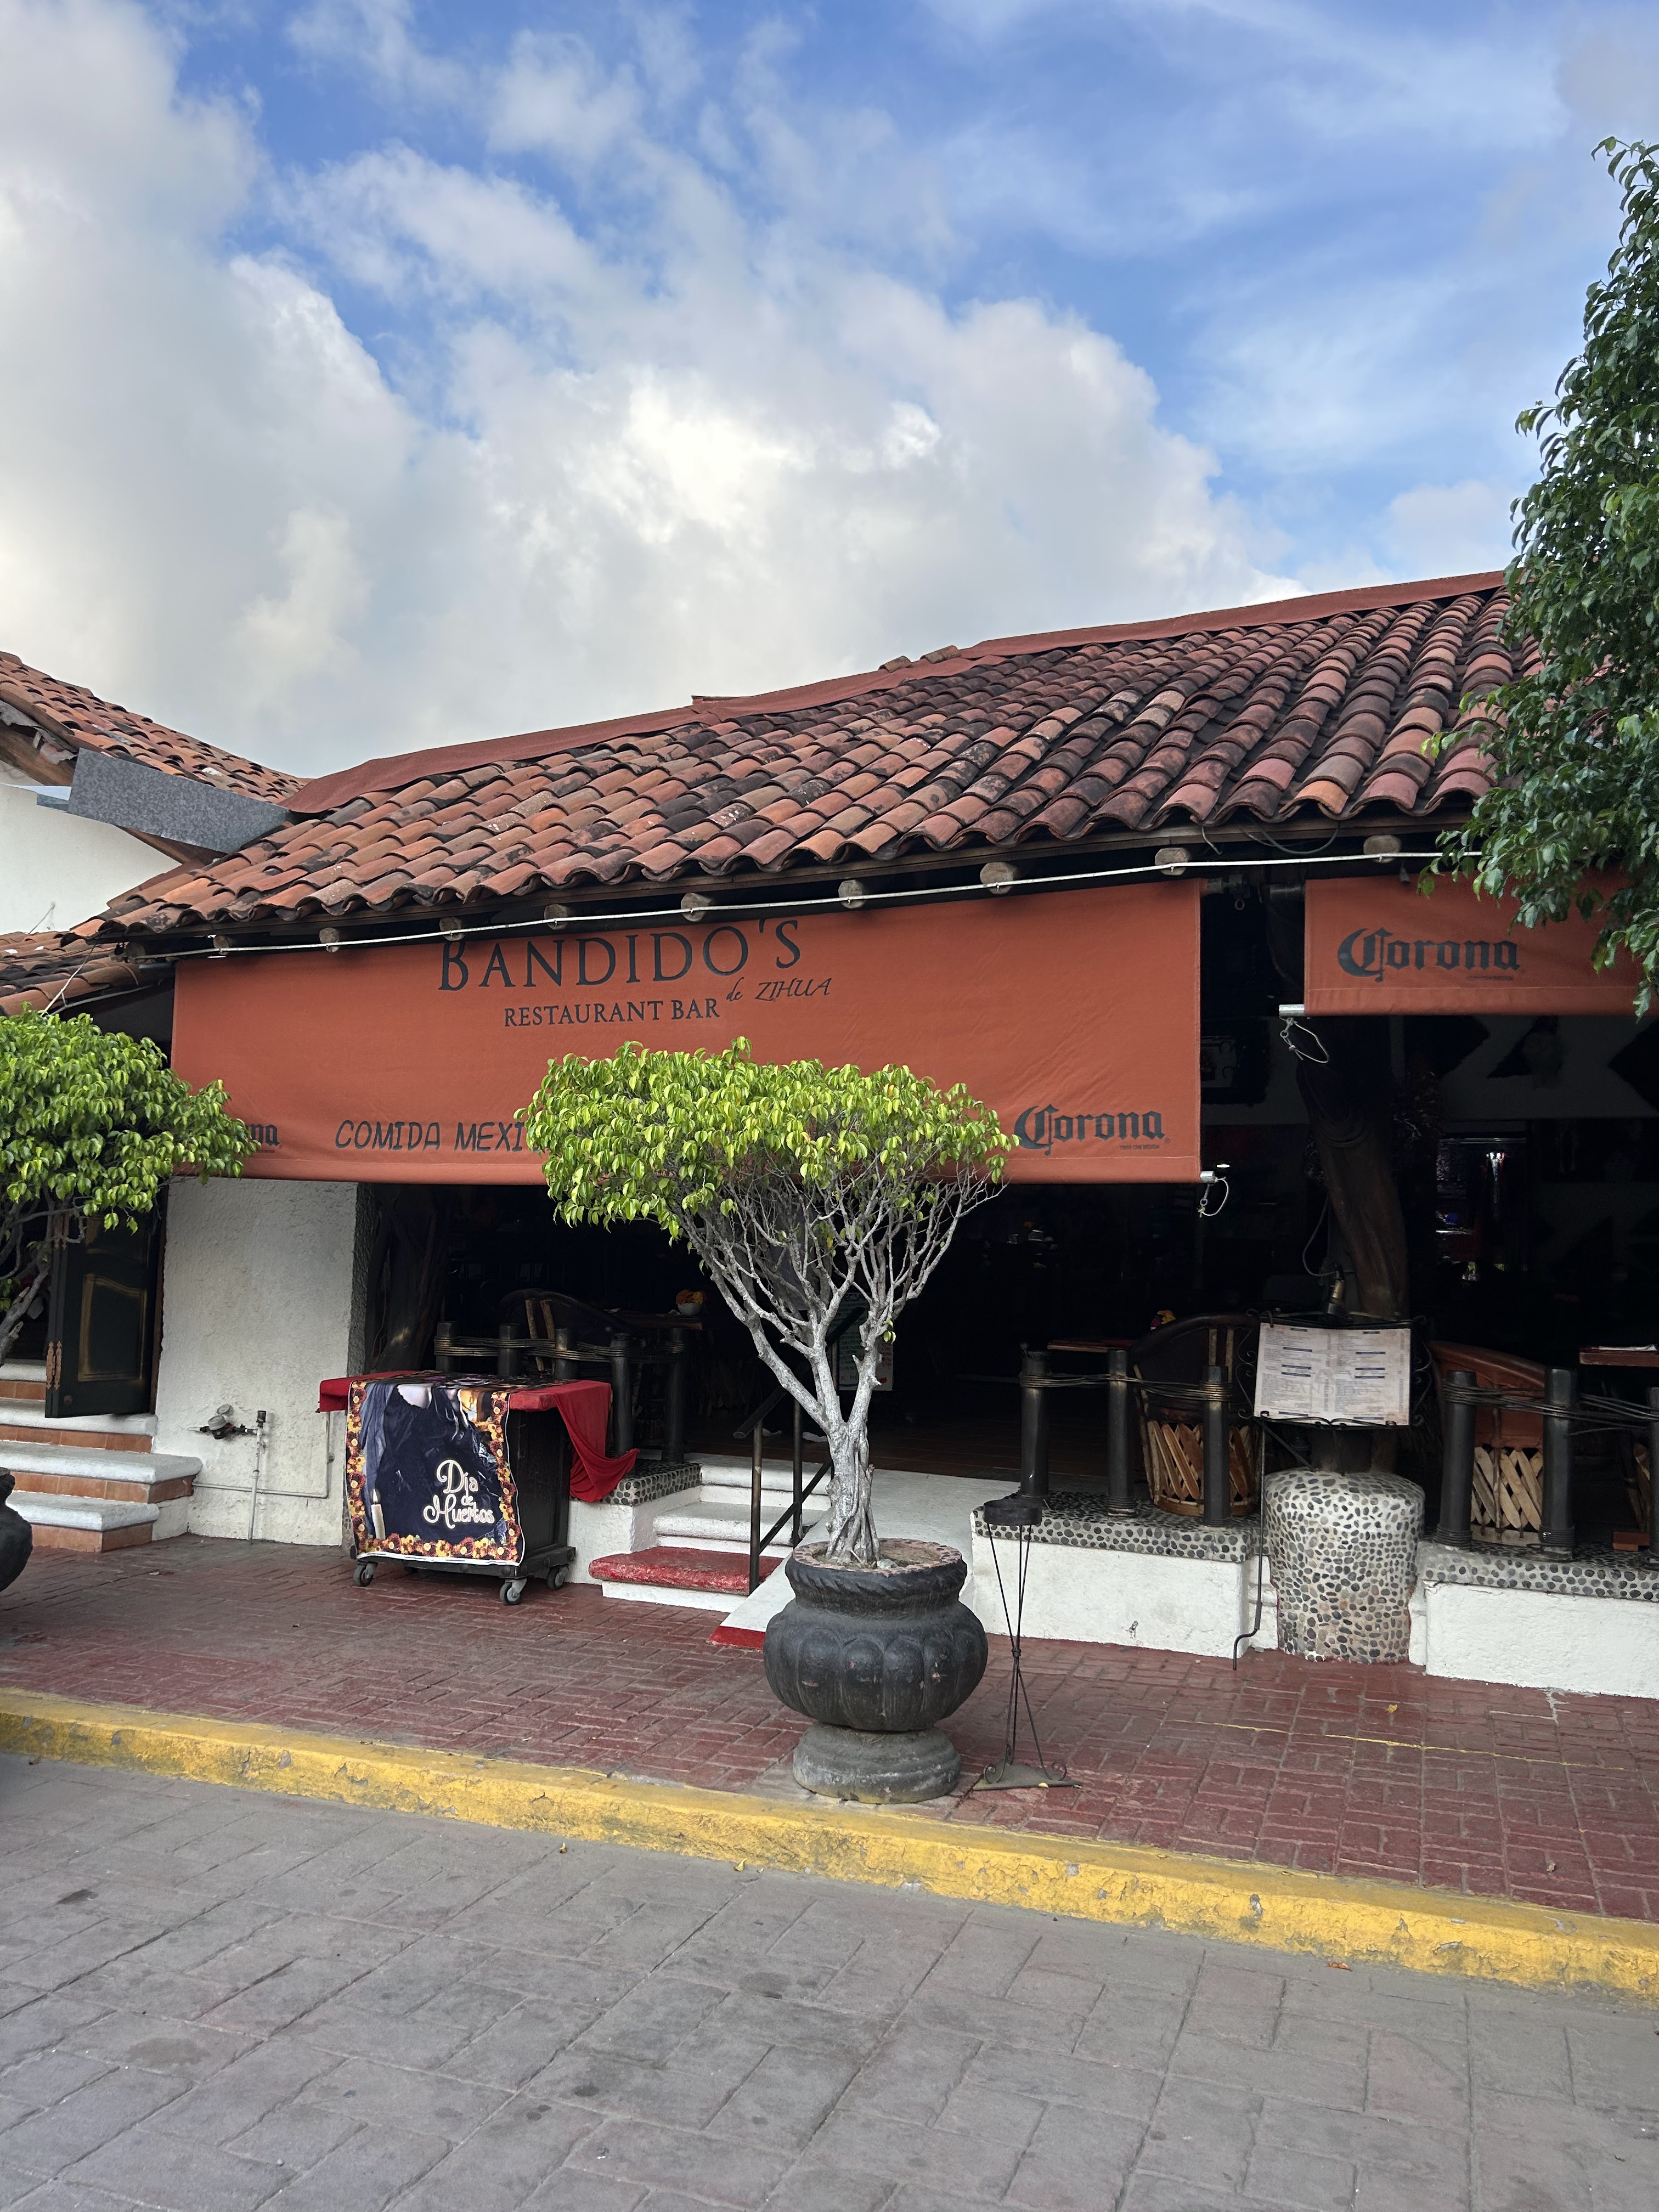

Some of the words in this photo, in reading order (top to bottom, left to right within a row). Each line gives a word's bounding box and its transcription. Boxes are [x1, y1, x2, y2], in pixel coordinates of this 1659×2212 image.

[438, 918, 802, 991] BANDIDO'S
[1337, 927, 1521, 983] Corona
[726, 977, 743, 1002] de
[504, 999, 664, 1028] RESTAURANT
[670, 997, 720, 1020] BAR
[335, 1119, 440, 1152] COMIDA
[454, 1121, 540, 1152] MEXI
[1014, 1103, 1166, 1156] Corona
[423, 1493, 495, 1529] Muertos
[461, 1492, 473, 1506] de
